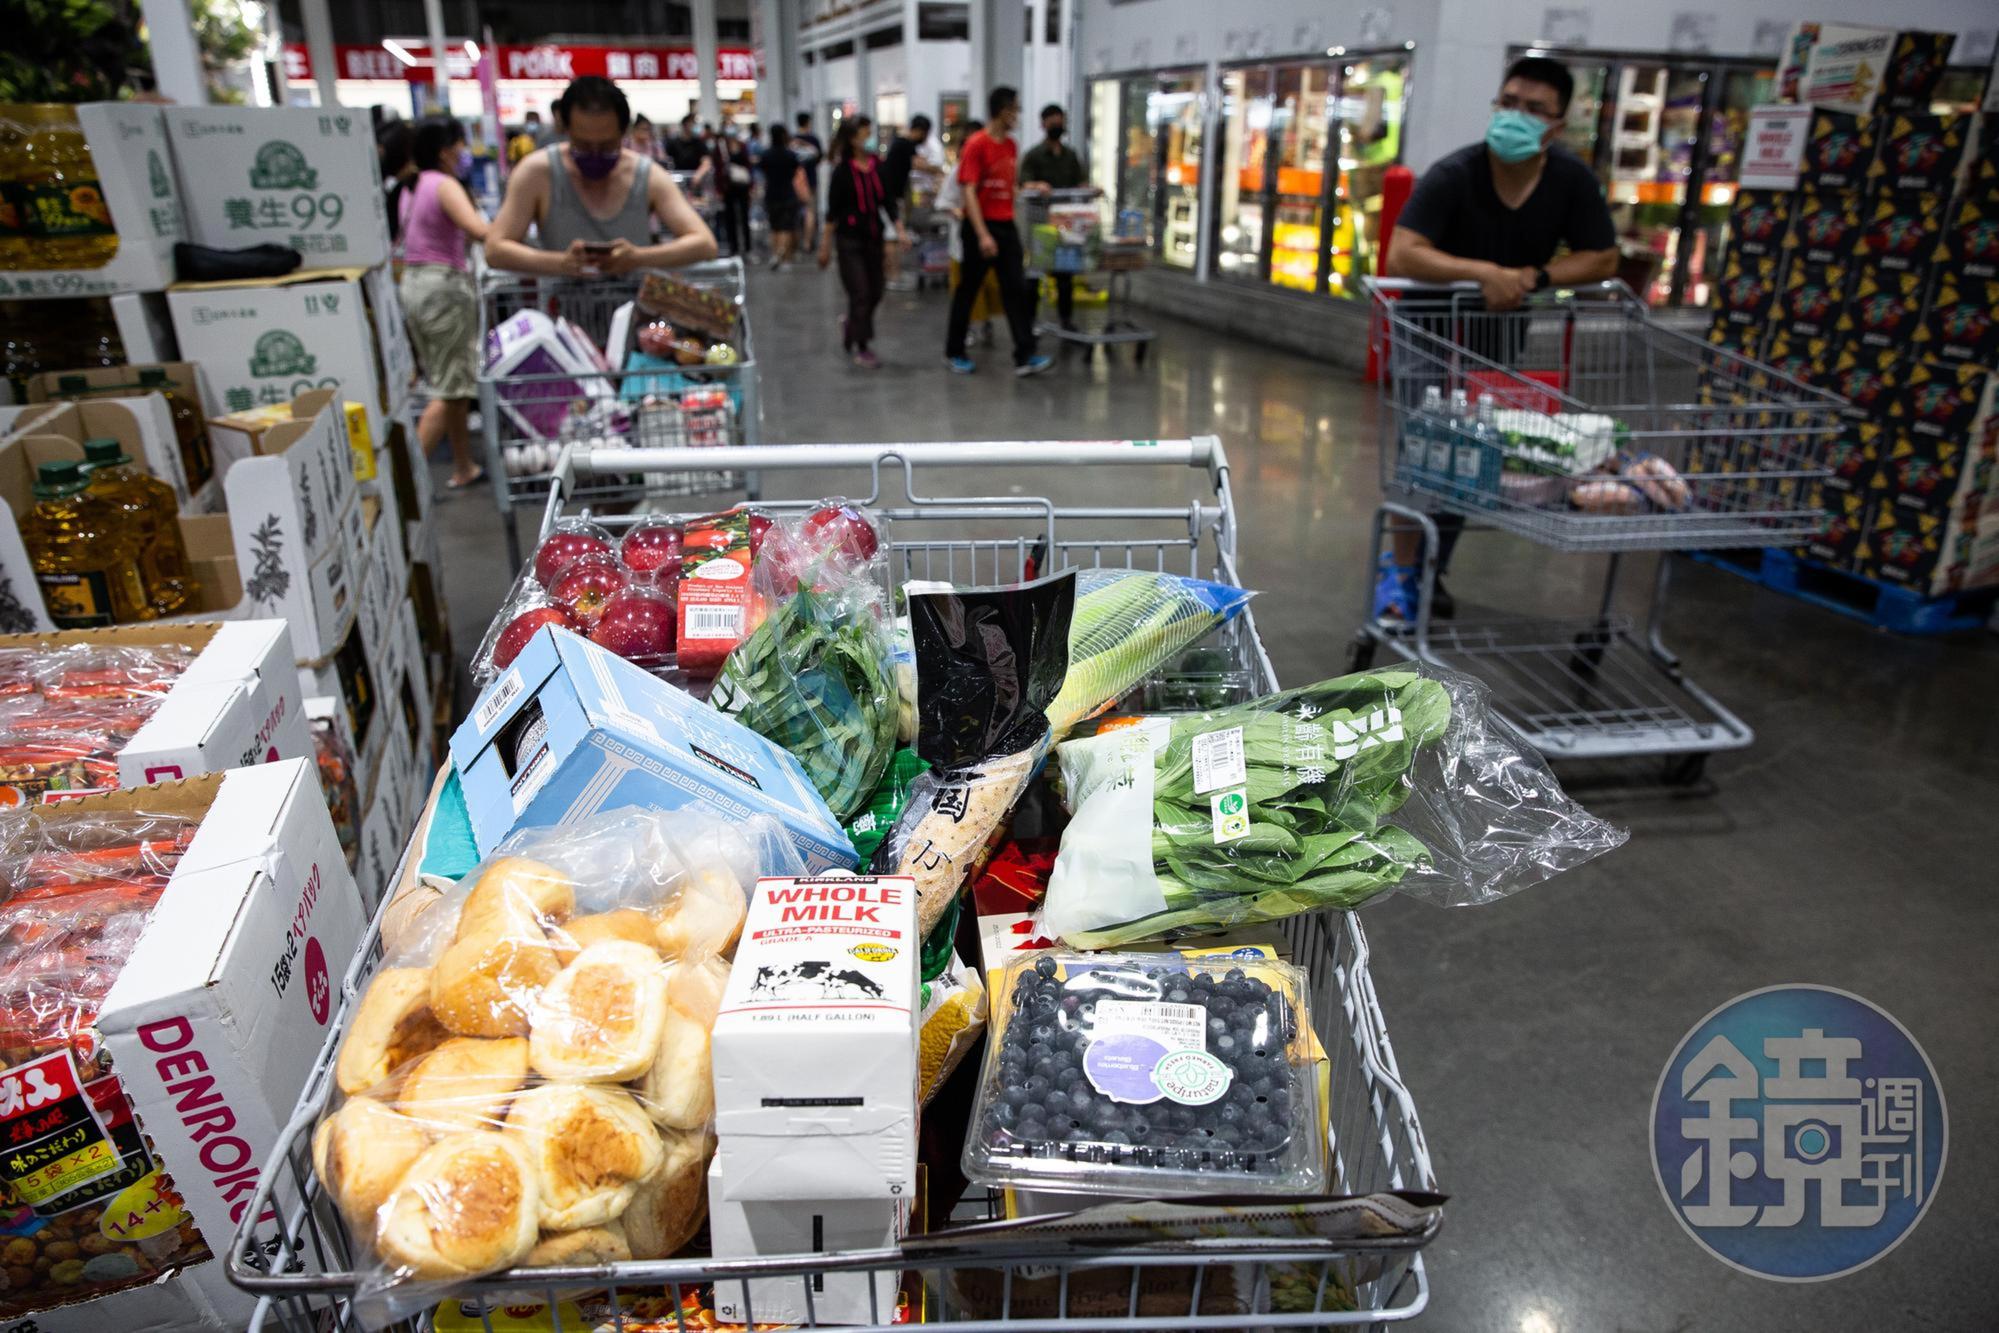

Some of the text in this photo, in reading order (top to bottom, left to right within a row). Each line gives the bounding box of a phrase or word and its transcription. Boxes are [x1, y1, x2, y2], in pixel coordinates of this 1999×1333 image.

[508, 51, 574, 78] PORK
[767, 887, 902, 905] WHOLE
[781, 905, 881, 923] MILK
[760, 936, 801, 945] GRADE
[762, 926, 892, 938] ULTRA-PASTEURIZED
[787, 1014, 819, 1022] (HALF
[825, 1014, 876, 1022] GALLON)
[1166, 1078, 1220, 1099] naturipe
